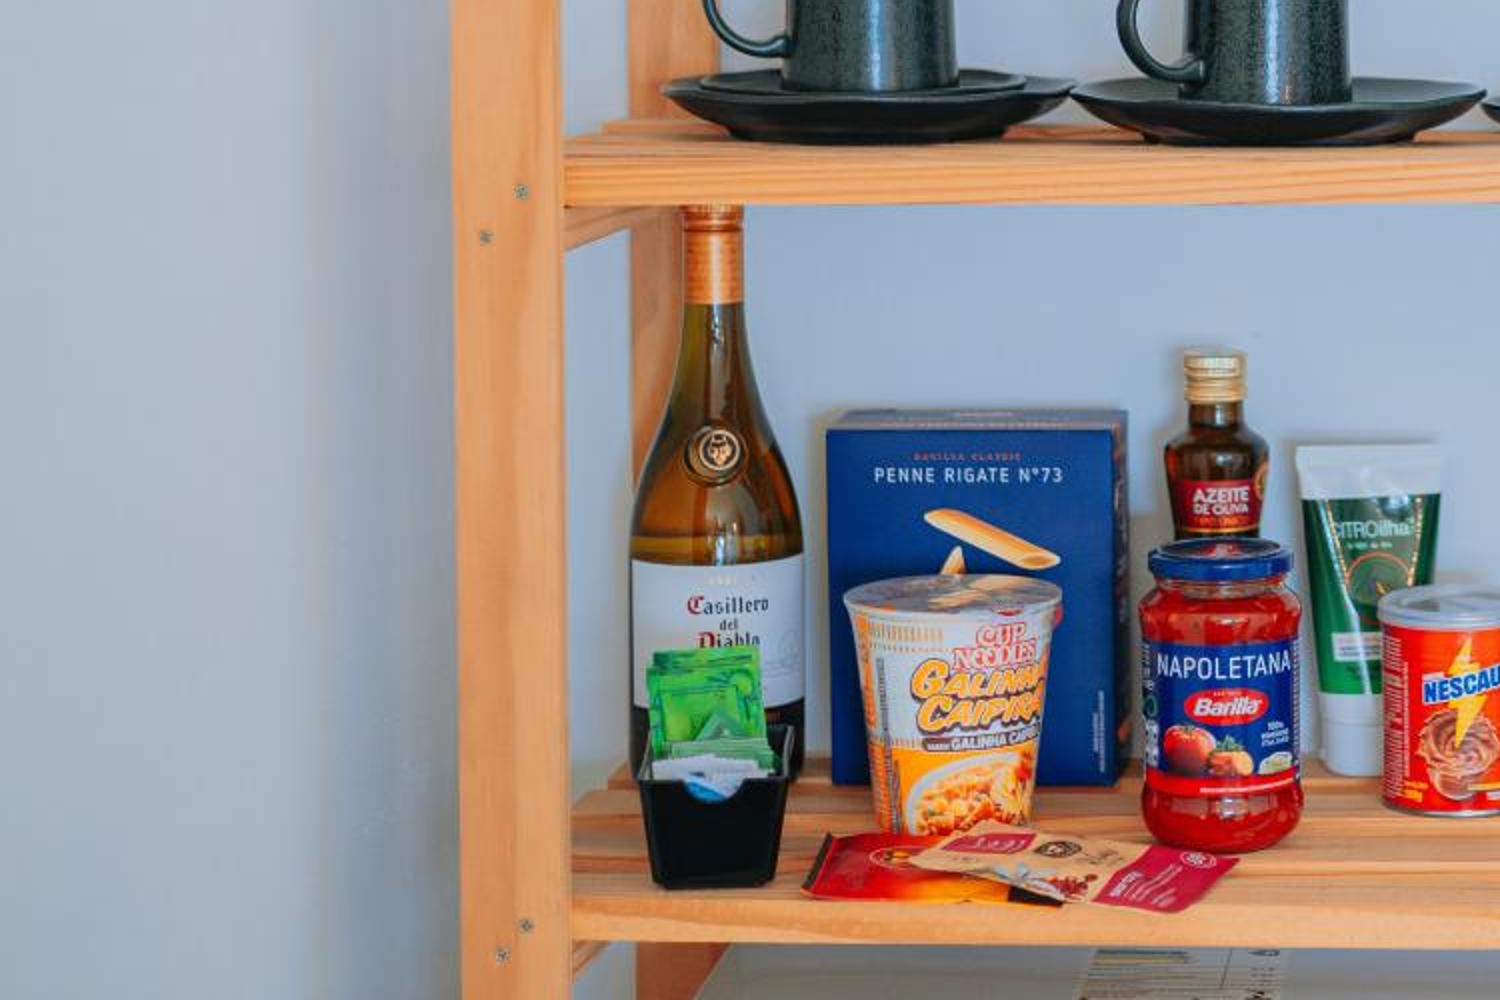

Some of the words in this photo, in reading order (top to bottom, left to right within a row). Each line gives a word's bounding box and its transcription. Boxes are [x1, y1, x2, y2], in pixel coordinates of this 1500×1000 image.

[874, 467, 935, 483] PENNE
[944, 467, 1009, 483] RIGATE
[1018, 467, 1063, 483] N°73
[1192, 486, 1250, 504] AZEITE
[1192, 503, 1210, 515] DE
[1211, 502, 1249, 516] OLIVA
[687, 595, 769, 615] Casillero
[719, 618, 738, 631] del
[1157, 650, 1291, 680] NAPOLETANA
[1194, 695, 1263, 717] Barilla
